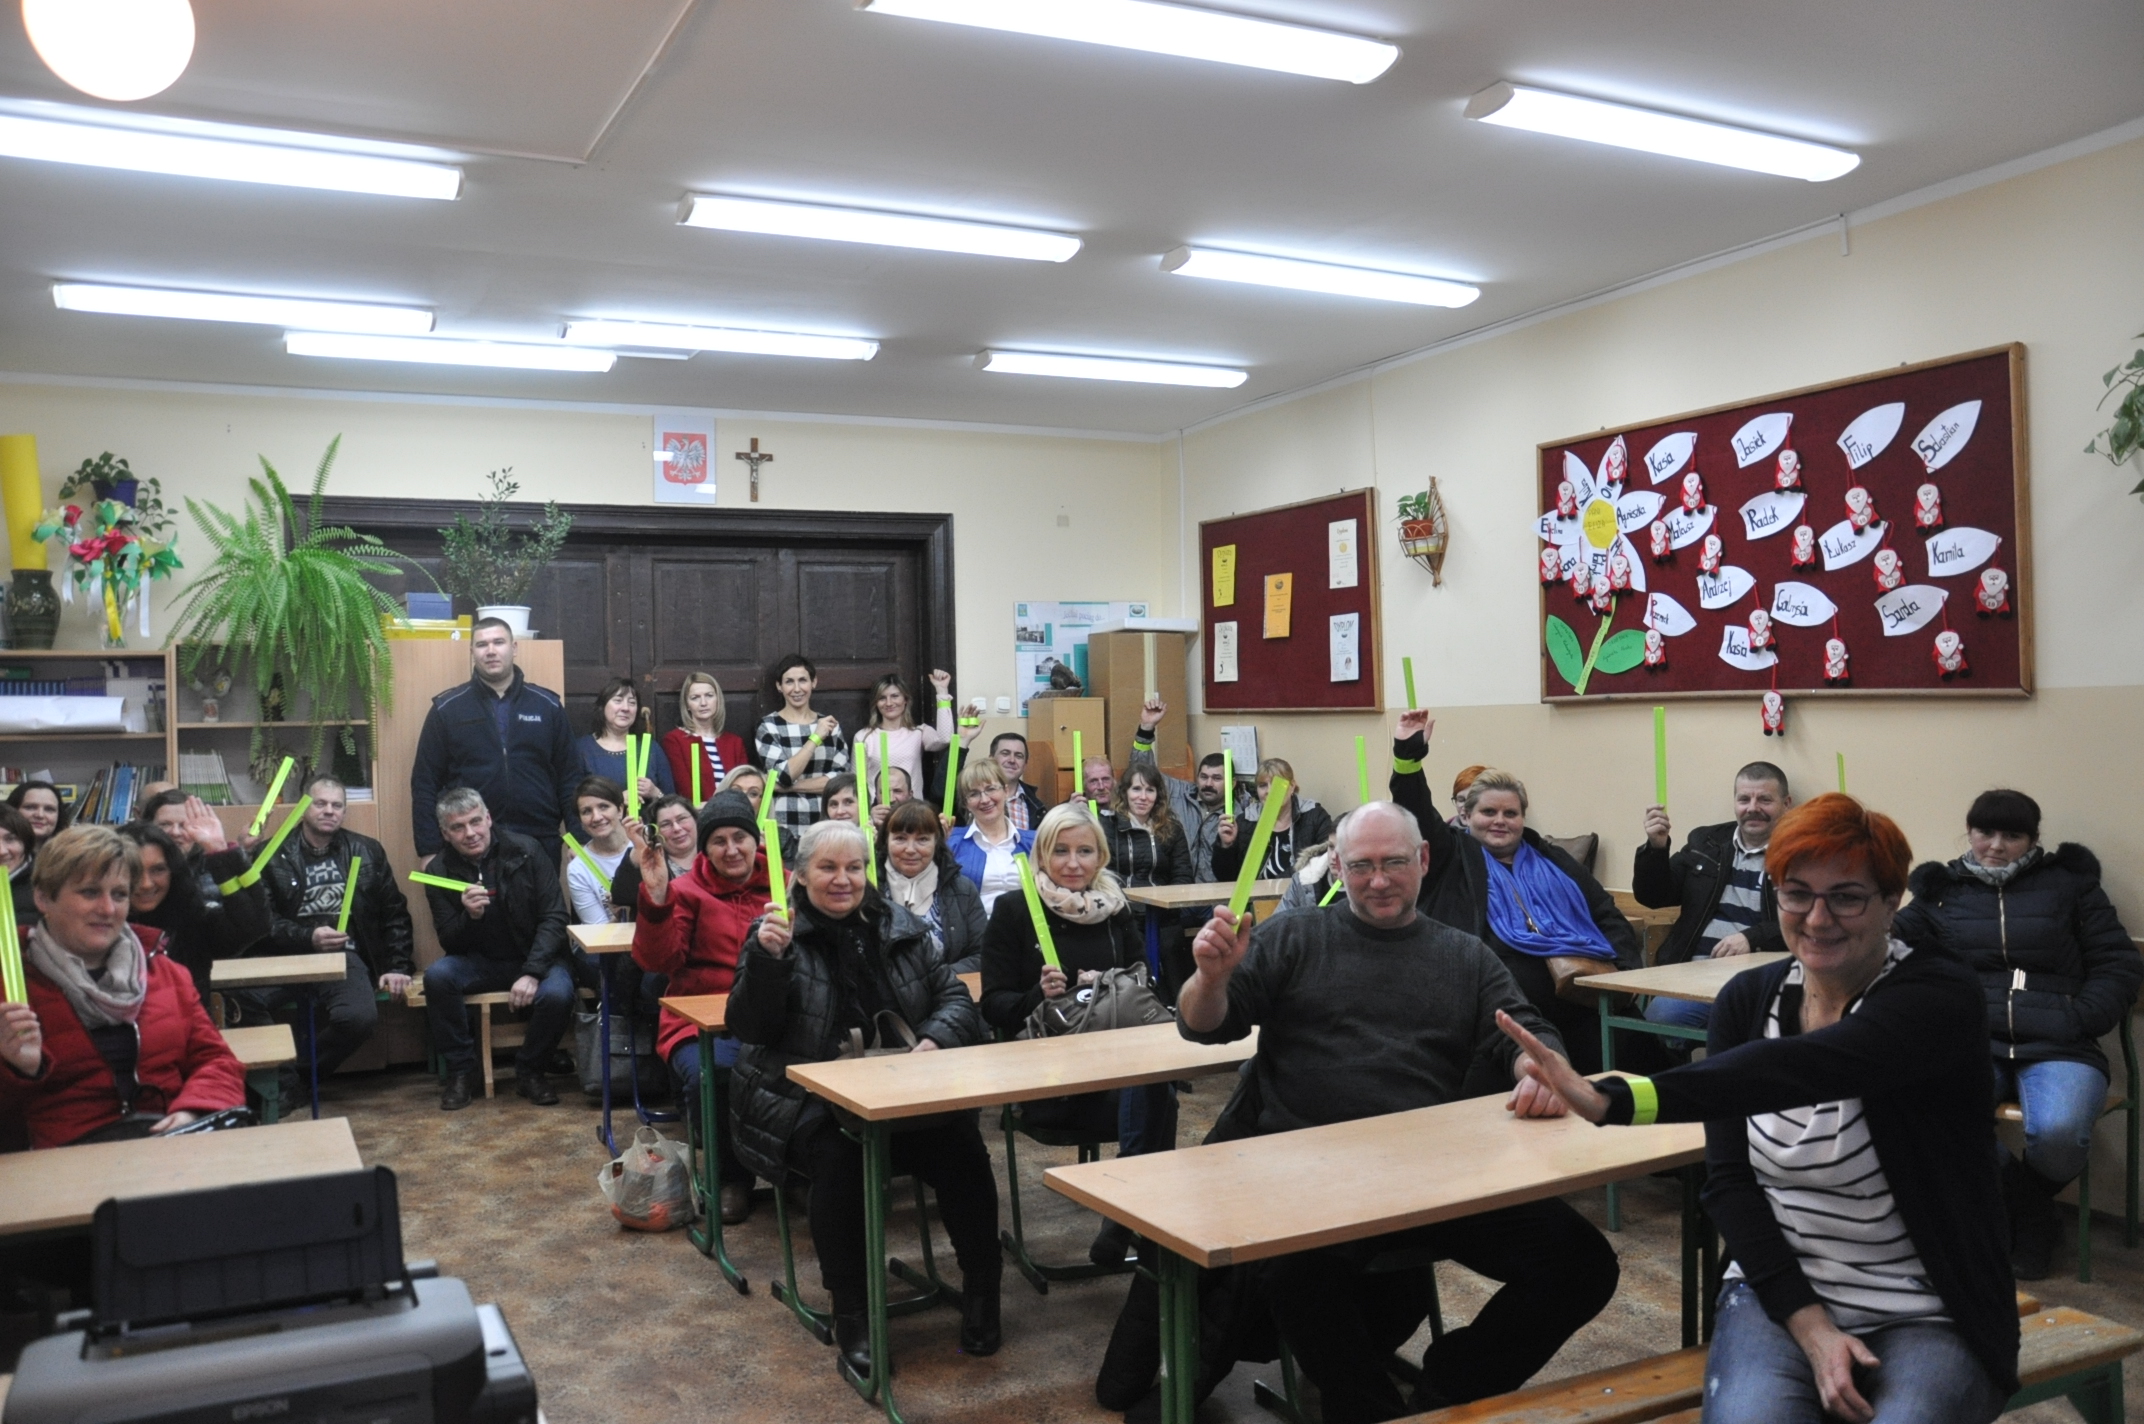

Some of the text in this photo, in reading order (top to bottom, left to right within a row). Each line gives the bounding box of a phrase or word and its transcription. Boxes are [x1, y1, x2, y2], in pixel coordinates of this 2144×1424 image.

[1736, 430, 1767, 461] Jasiek
[1842, 434, 1875, 464] Filip
[1649, 452, 1676, 477] Kasia
[1745, 505, 1780, 532] Radek
[1823, 538, 1857, 560] Łukasz
[1931, 541, 1965, 566] Kamila
[1702, 577, 1732, 601] Andrzej
[1881, 598, 1922, 629] Sandra
[1726, 630, 1748, 657] Kasia
[518, 713, 542, 723] POLICJA
